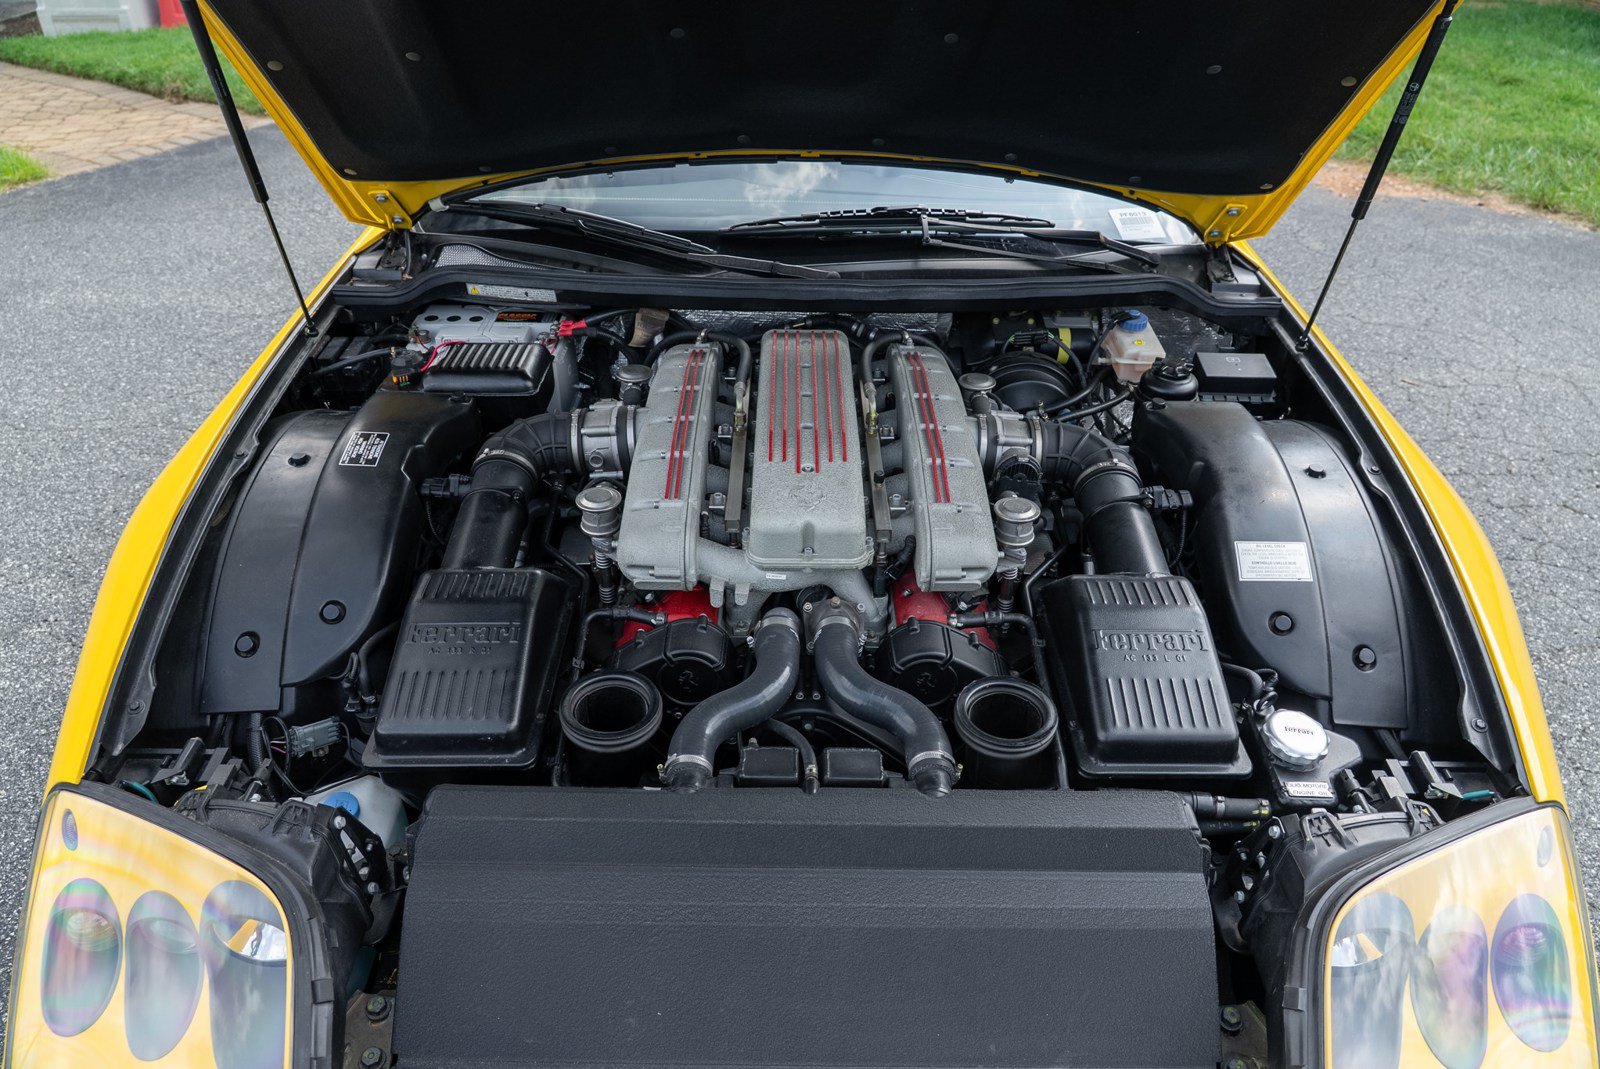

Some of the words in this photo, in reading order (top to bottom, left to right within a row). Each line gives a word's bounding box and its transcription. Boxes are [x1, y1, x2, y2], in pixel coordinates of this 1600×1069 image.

[1123, 654, 1137, 662] AC
[1141, 654, 1159, 662] 133
[1163, 654, 1171, 662] L
